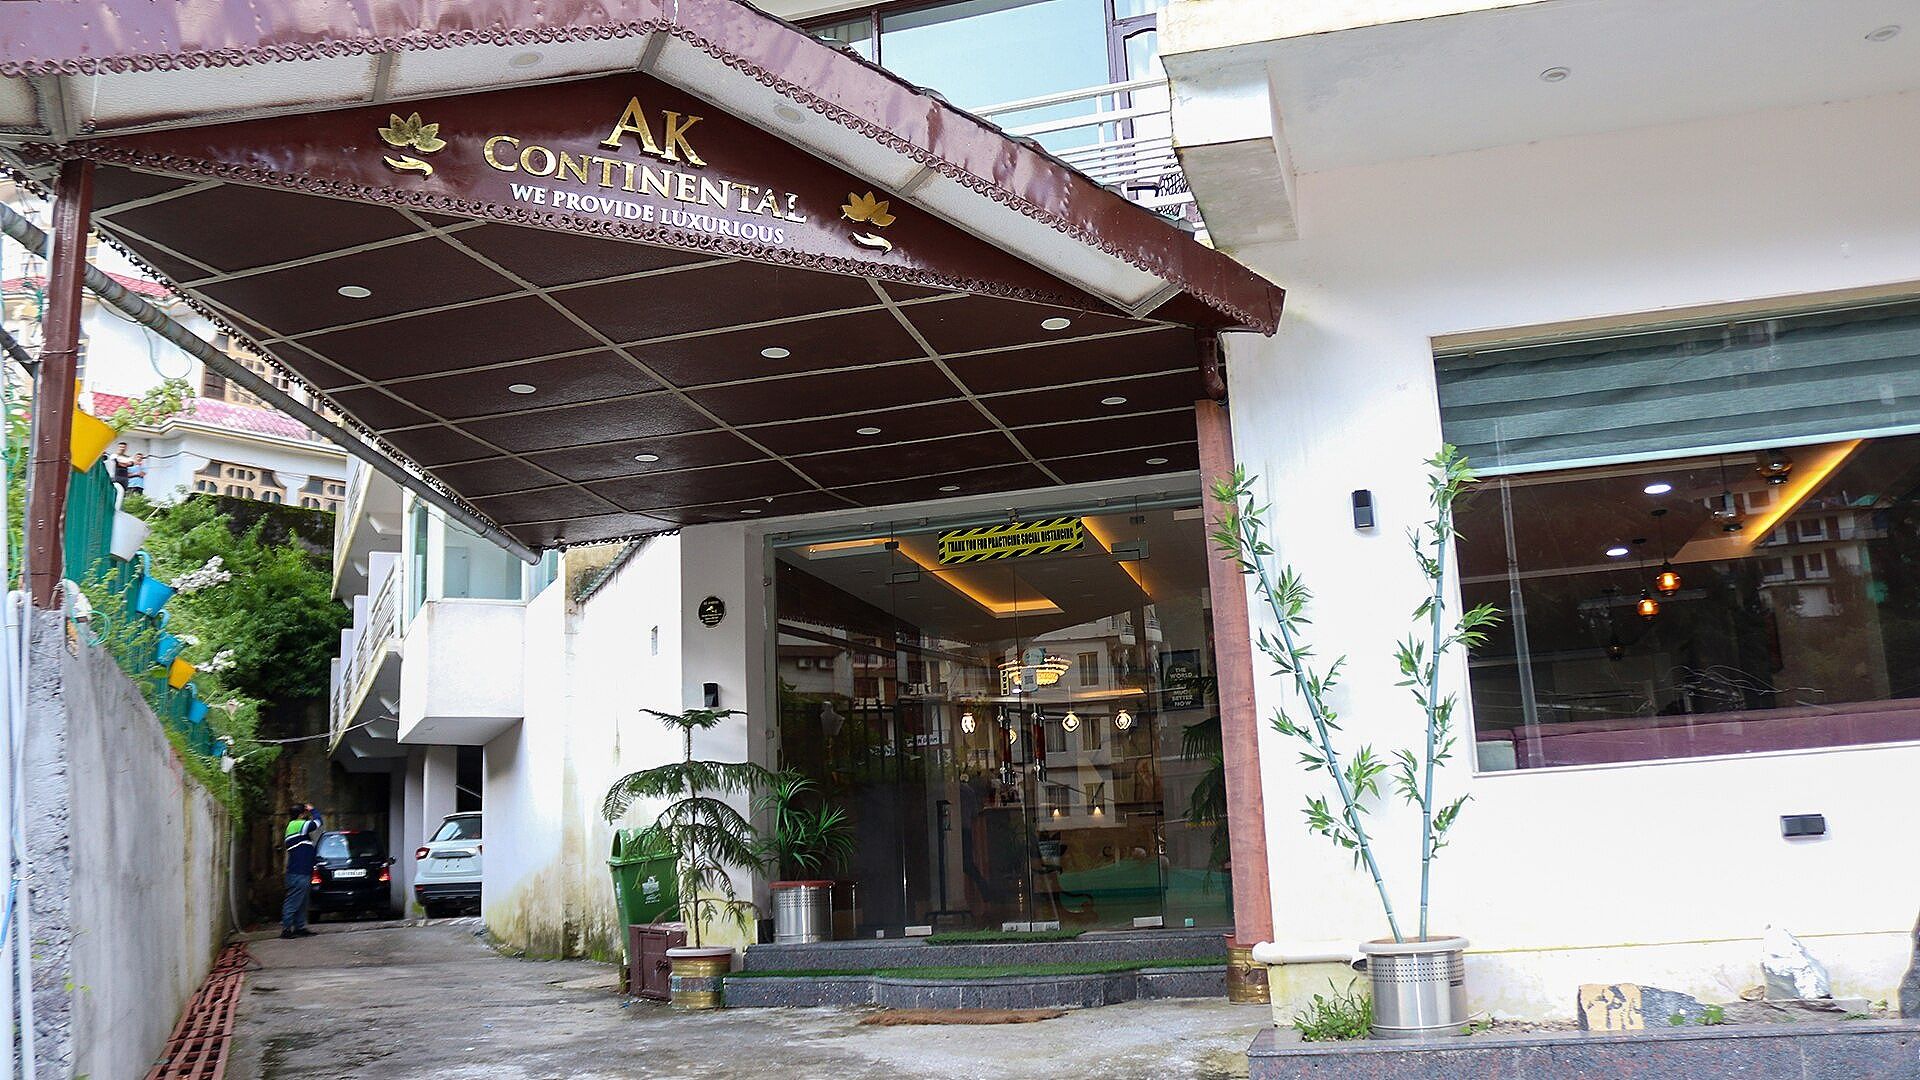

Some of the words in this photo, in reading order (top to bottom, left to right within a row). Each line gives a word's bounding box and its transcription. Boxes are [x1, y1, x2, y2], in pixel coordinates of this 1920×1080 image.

[600, 96, 707, 167] AK
[483, 135, 807, 224] CONTINENTAL
[510, 182, 547, 205] WE
[552, 190, 654, 222] PROVIDE
[660, 208, 785, 245] LUXURIOUS
[947, 540, 966, 553] THANK
[966, 539, 977, 551] YOU
[978, 538, 988, 550] FOR
[988, 534, 1021, 549] PRACTICING
[1021, 531, 1041, 546] SOCIAL
[1041, 527, 1074, 542] DISTANCING
